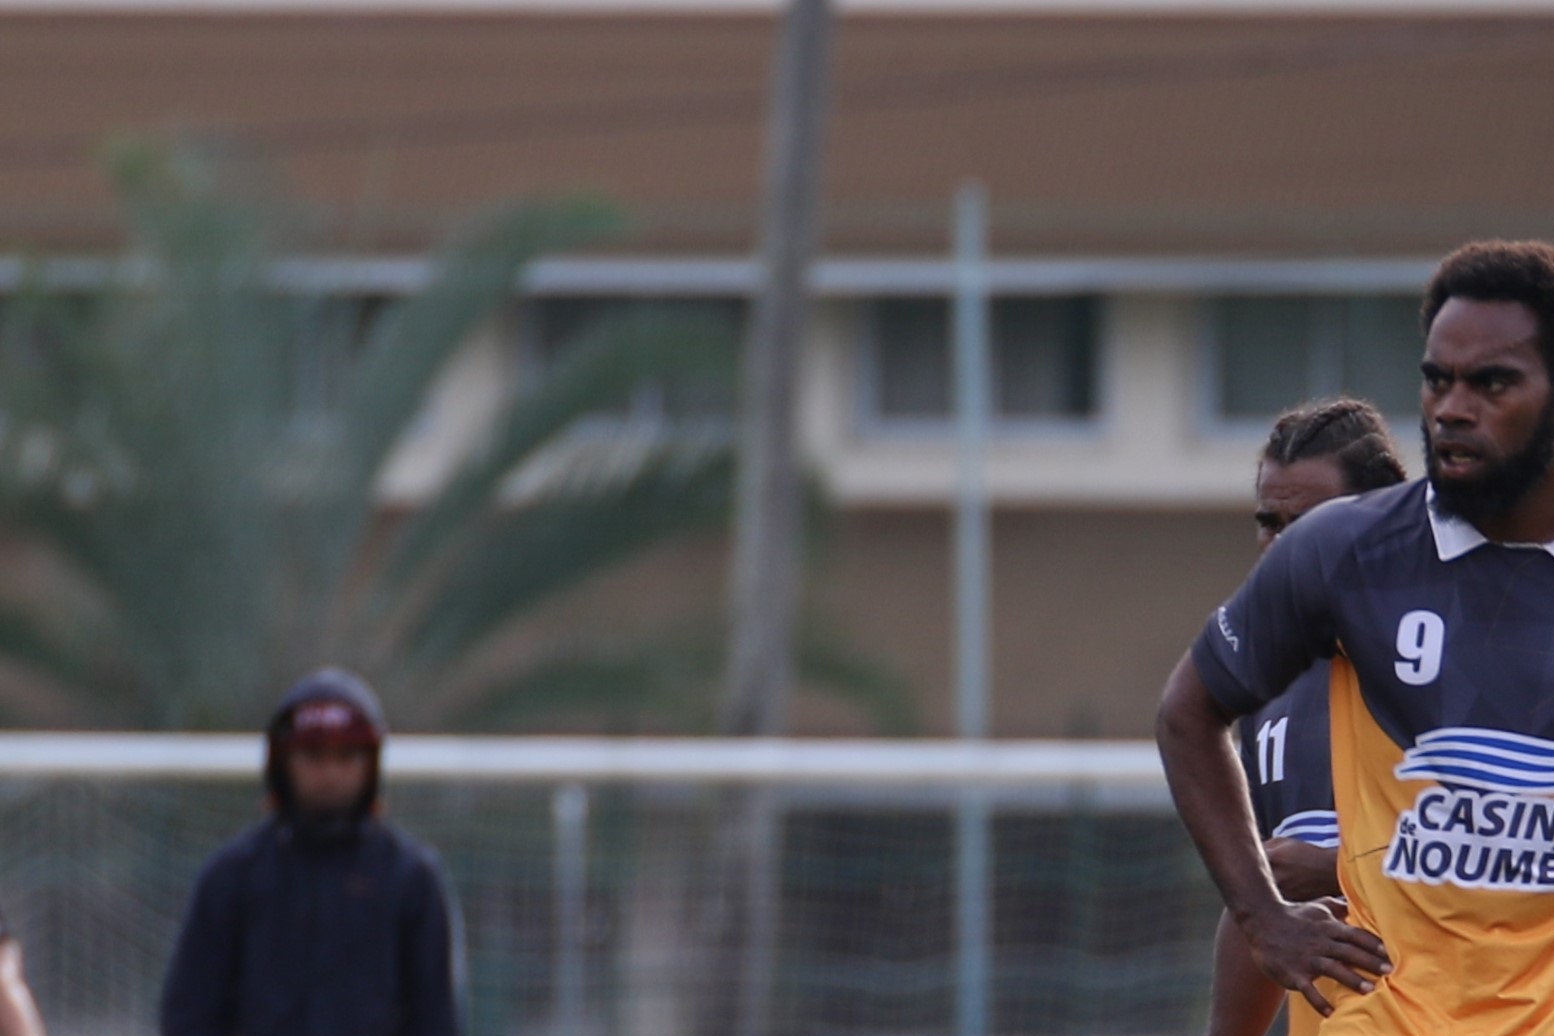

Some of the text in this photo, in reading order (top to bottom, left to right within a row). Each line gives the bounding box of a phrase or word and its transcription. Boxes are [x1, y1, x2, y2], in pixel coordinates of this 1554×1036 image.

[1394, 609, 1445, 686] 9
[1256, 717, 1288, 785] 11
[1399, 816, 1417, 836] de
